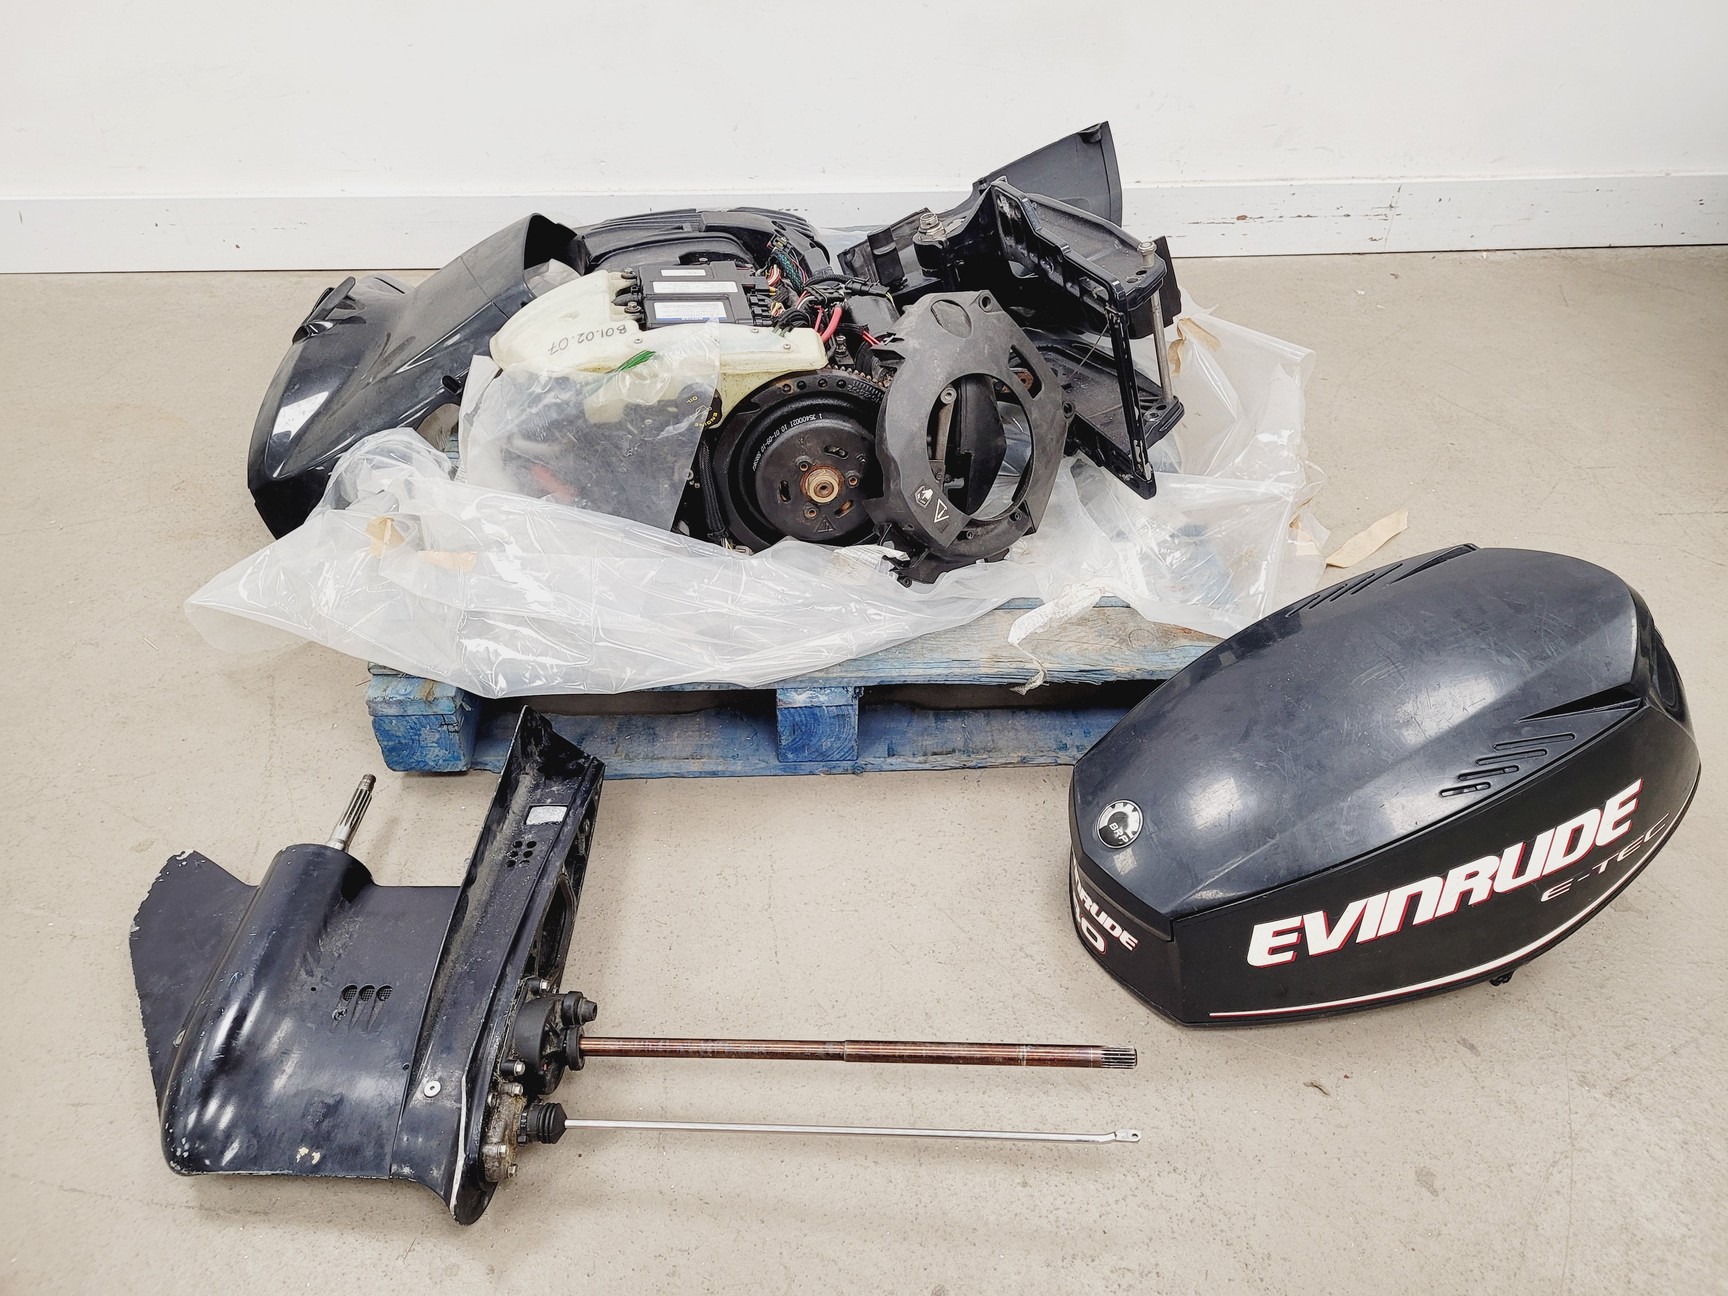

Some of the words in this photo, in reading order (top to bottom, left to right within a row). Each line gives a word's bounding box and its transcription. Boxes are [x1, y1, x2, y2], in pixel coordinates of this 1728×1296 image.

[1108, 822, 1129, 843] BRP
[1246, 778, 1645, 968] EVINRUDE
[1540, 811, 1670, 902] E-TEC
